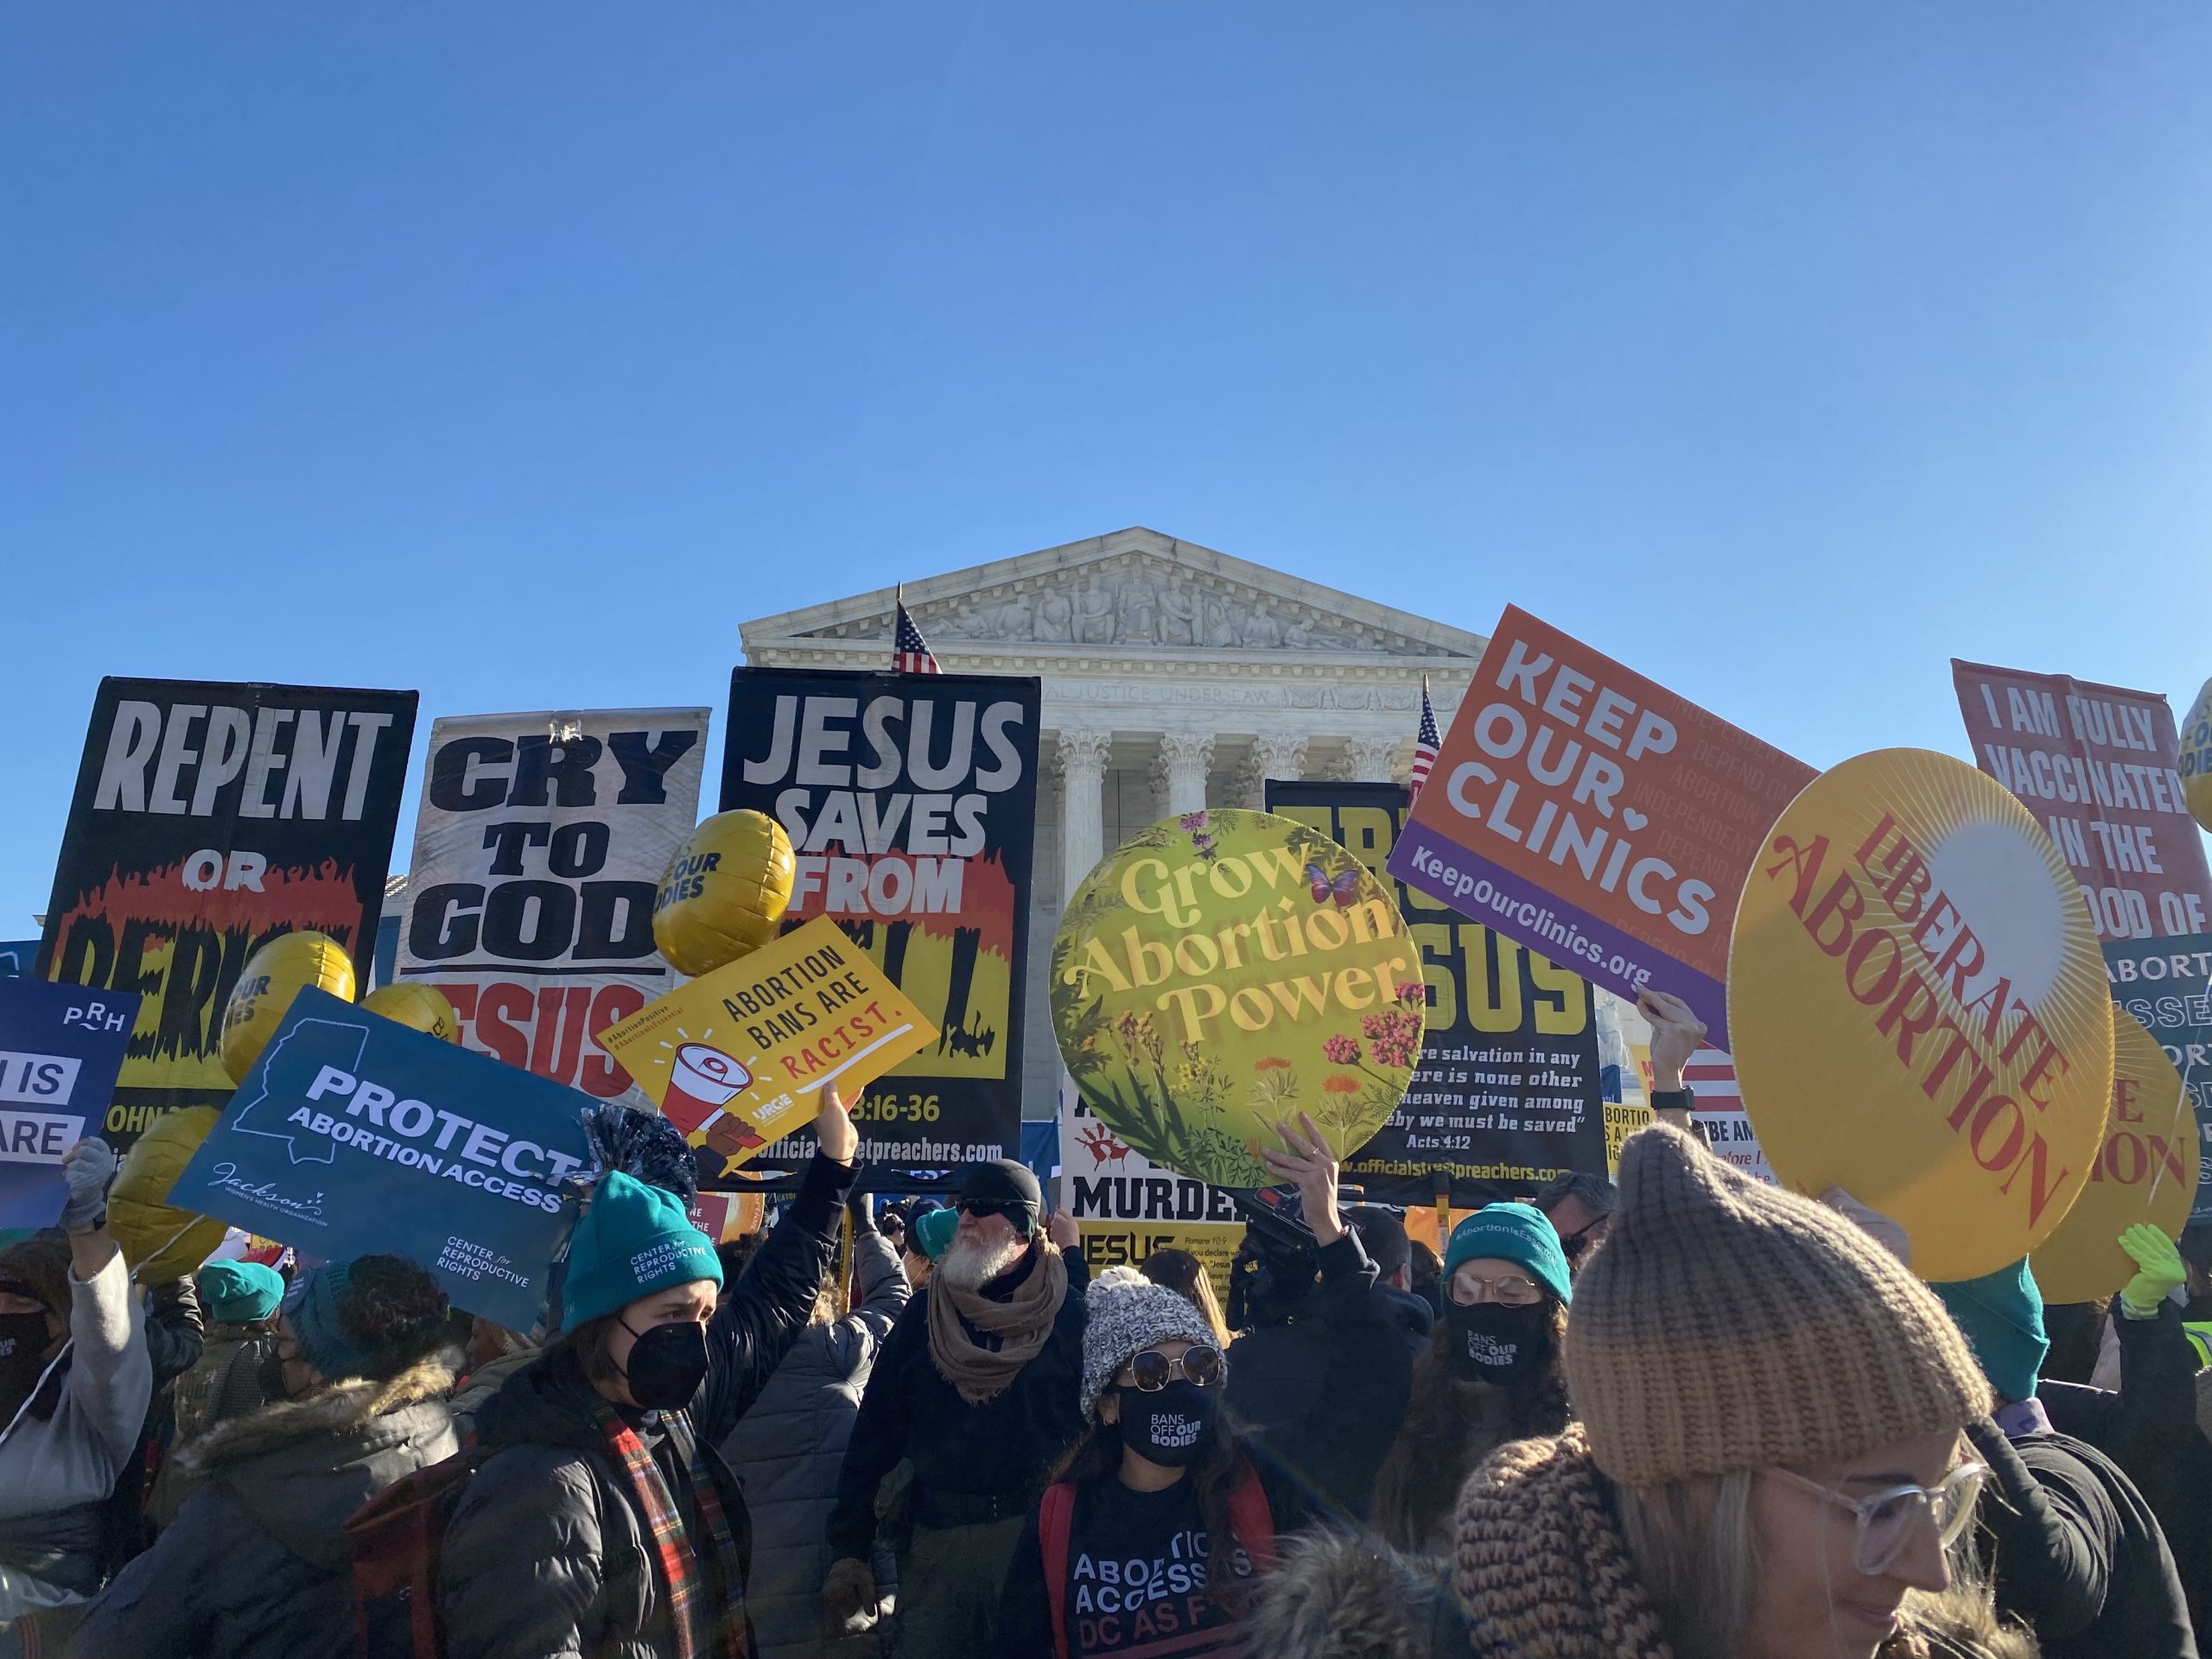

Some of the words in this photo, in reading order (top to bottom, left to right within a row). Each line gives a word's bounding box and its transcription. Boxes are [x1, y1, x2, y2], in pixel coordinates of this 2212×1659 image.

[1075, 685, 1151, 701] JUSTICE
[1160, 687, 1221, 702] UNDER
[1232, 690, 1270, 702] LAW
[1496, 639, 1677, 761] KEEP
[1980, 683, 2002, 729] I
[2006, 687, 2062, 739] AM
[2065, 695, 2157, 752] FULLY
[93, 700, 393, 822] REPENT
[743, 694, 1024, 793] JESUS
[1474, 702, 1624, 819] OUR
[430, 730, 699, 811] CRY
[1670, 763, 1760, 824] ABORTION
[775, 787, 988, 858] SAVES
[483, 822, 610, 879] TO
[1446, 761, 1715, 935] CLINICS
[2049, 816, 2090, 868] IN
[2090, 822, 2164, 874] THE
[181, 849, 268, 893] OR
[791, 857, 964, 916] FROM
[1121, 842, 1312, 930] Grow
[409, 880, 658, 961] GOD
[1411, 845, 1652, 993] KeepOurClinics.org
[2159, 893, 2206, 936] OF
[1064, 896, 1395, 1000] Abortion
[1854, 811, 2071, 1111] LIBERATE
[722, 944, 846, 1022] ABORTION
[1157, 956, 1406, 1042] Power
[63, 1002, 125, 1032] PRH
[607, 1006, 669, 1044] #AbortionPositive
[613, 1007, 684, 1051] #AbortionIsEssential
[747, 1001, 818, 1050] BANS
[817, 971, 869, 1014] ARE
[1766, 833, 2070, 1230] ABORTION
[779, 1001, 903, 1080] RACIST.
[1441, 1044, 1521, 1064] salvation
[1529, 1047, 1545, 1064] in
[1551, 1052, 1580, 1069] any
[18, 1061, 65, 1095] IS
[1448, 1068, 1467, 1083] is
[1475, 1071, 1521, 1086] none
[1529, 1070, 1583, 1088] other
[752, 1093, 793, 1121] URGE
[1421, 1116, 1444, 1128] we
[1449, 1116, 1494, 1129] must
[1498, 1114, 1518, 1130] be
[1469, 1090, 1518, 1110] given
[1524, 1096, 1584, 1114] among
[306, 1065, 582, 1187] PROTECT
[1406, 1134, 1439, 1149] Acts
[1444, 1135, 1471, 1150] 4:12
[288, 1107, 443, 1175] ABORTION
[442, 1164, 563, 1214] ACCESS
[255, 1199, 278, 1211] HEALTH
[279, 1207, 328, 1227] ORGANIZATION
[1072, 1176, 1249, 1222] MURDE
[448, 1236, 494, 1261] CENTER
[496, 1255, 512, 1266] for
[630, 1243, 671, 1267] CENTER
[633, 1246, 706, 1276] REPRODUCTIVE
[1185, 1236, 1211, 1245] Romans
[436, 1257, 481, 1281] RIGHTS
[442, 1246, 531, 1288] REPRODUCTIVE
[637, 1262, 677, 1284] RIGHTS
[1467, 1329, 1496, 1345] BANS
[1467, 1339, 1486, 1352] OFF
[1488, 1344, 1517, 1356] OUR
[1469, 1349, 1513, 1366] BODIES
[1151, 1414, 1185, 1426] BANS
[1151, 1425, 1175, 1436] OFF
[1176, 1421, 1201, 1435] OUR
[1151, 1433, 1198, 1447] BODIES
[1079, 1615, 1122, 1649] DC
[1134, 1603, 1180, 1640] AS
